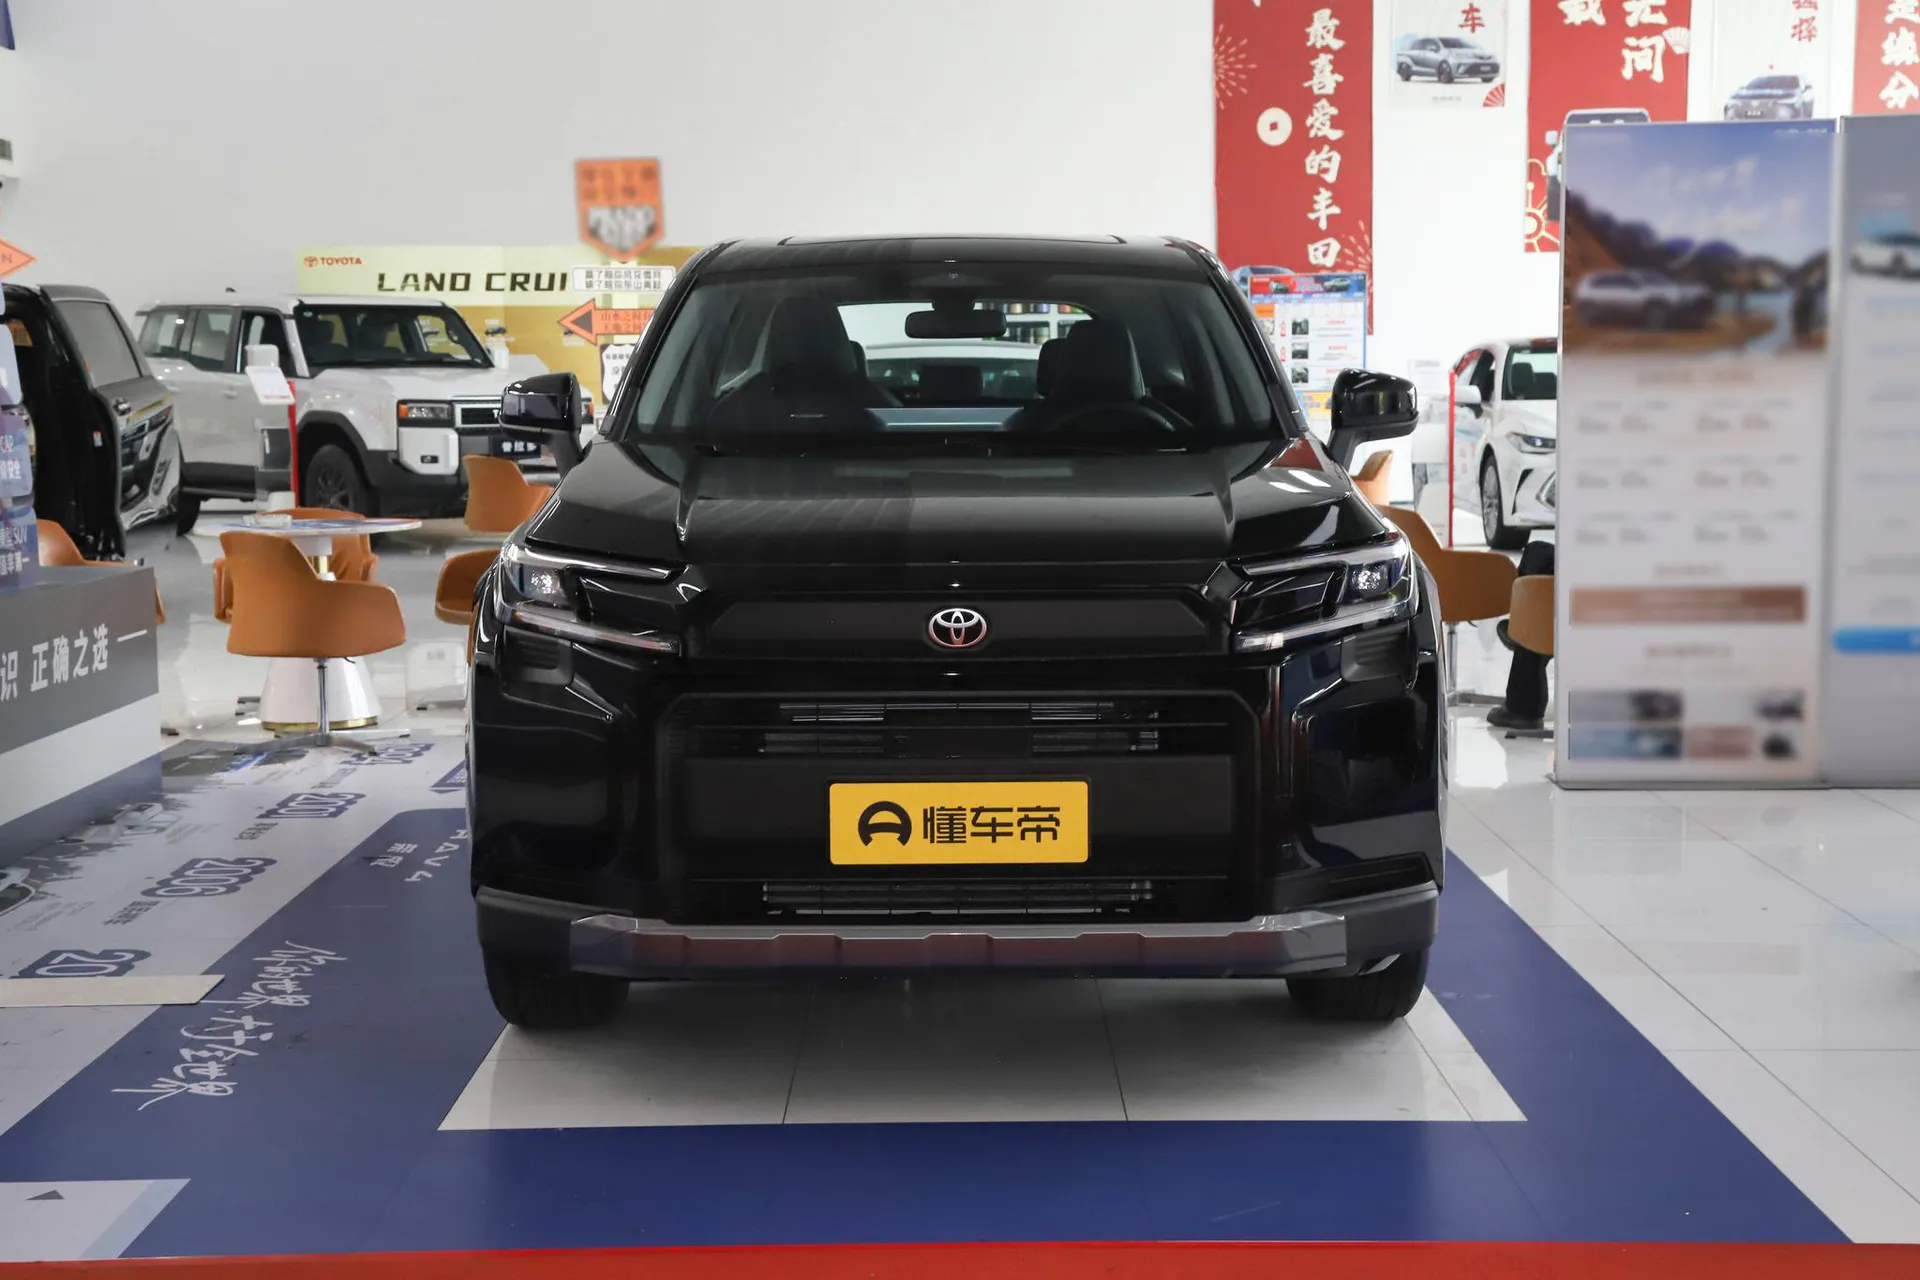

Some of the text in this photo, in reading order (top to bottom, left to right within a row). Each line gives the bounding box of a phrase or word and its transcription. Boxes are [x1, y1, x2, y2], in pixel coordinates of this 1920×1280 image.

[1304, 8, 1346, 268] 最喜爱的丰田
[320, 256, 362, 266] TOYOTA
[377, 272, 471, 292] LAND
[31, 623, 109, 692] 正确之选
[922, 805, 1061, 844] 懂车帝
[154, 857, 268, 897] 2006
